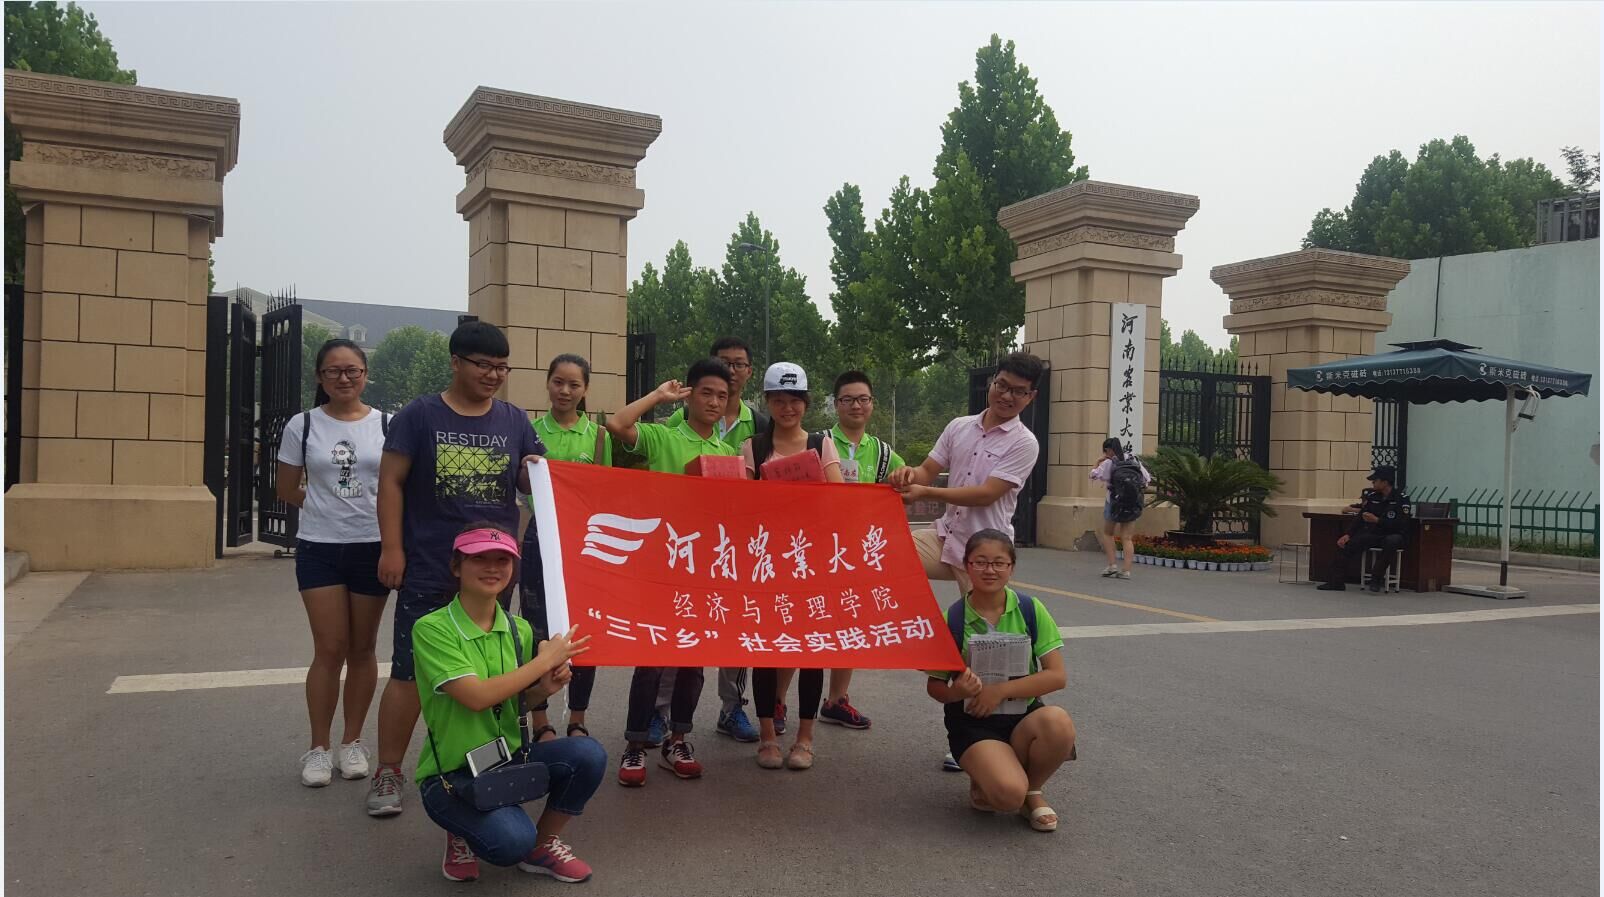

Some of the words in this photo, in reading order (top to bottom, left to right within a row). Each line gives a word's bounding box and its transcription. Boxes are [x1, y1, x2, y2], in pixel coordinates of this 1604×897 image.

[436, 431, 508, 447] RESTDAY
[673, 585, 899, 626] 经济与管理学院
